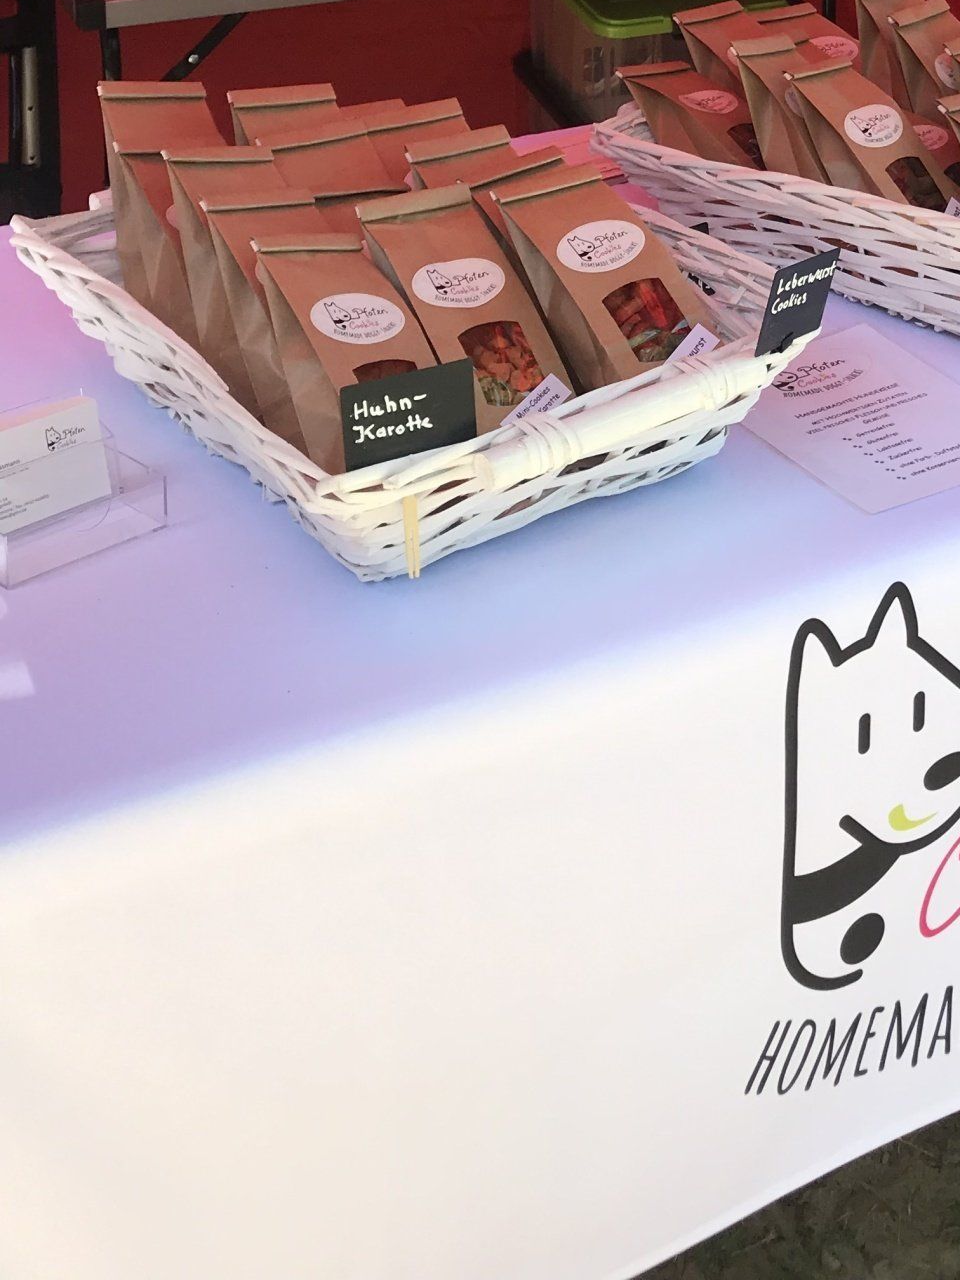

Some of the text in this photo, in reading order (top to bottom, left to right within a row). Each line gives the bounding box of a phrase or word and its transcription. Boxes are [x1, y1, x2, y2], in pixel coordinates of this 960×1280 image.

[594, 230, 628, 246] Pfoten
[452, 271, 489, 286] Pfoten
[352, 306, 389, 319] Pfoten
[771, 292, 808, 315] Cookies
[797, 359, 846, 376] Pfoten
[353, 393, 427, 420] Huhn-
[516, 386, 551, 419] Mini-Cookies
[352, 414, 433, 443] Karotte
